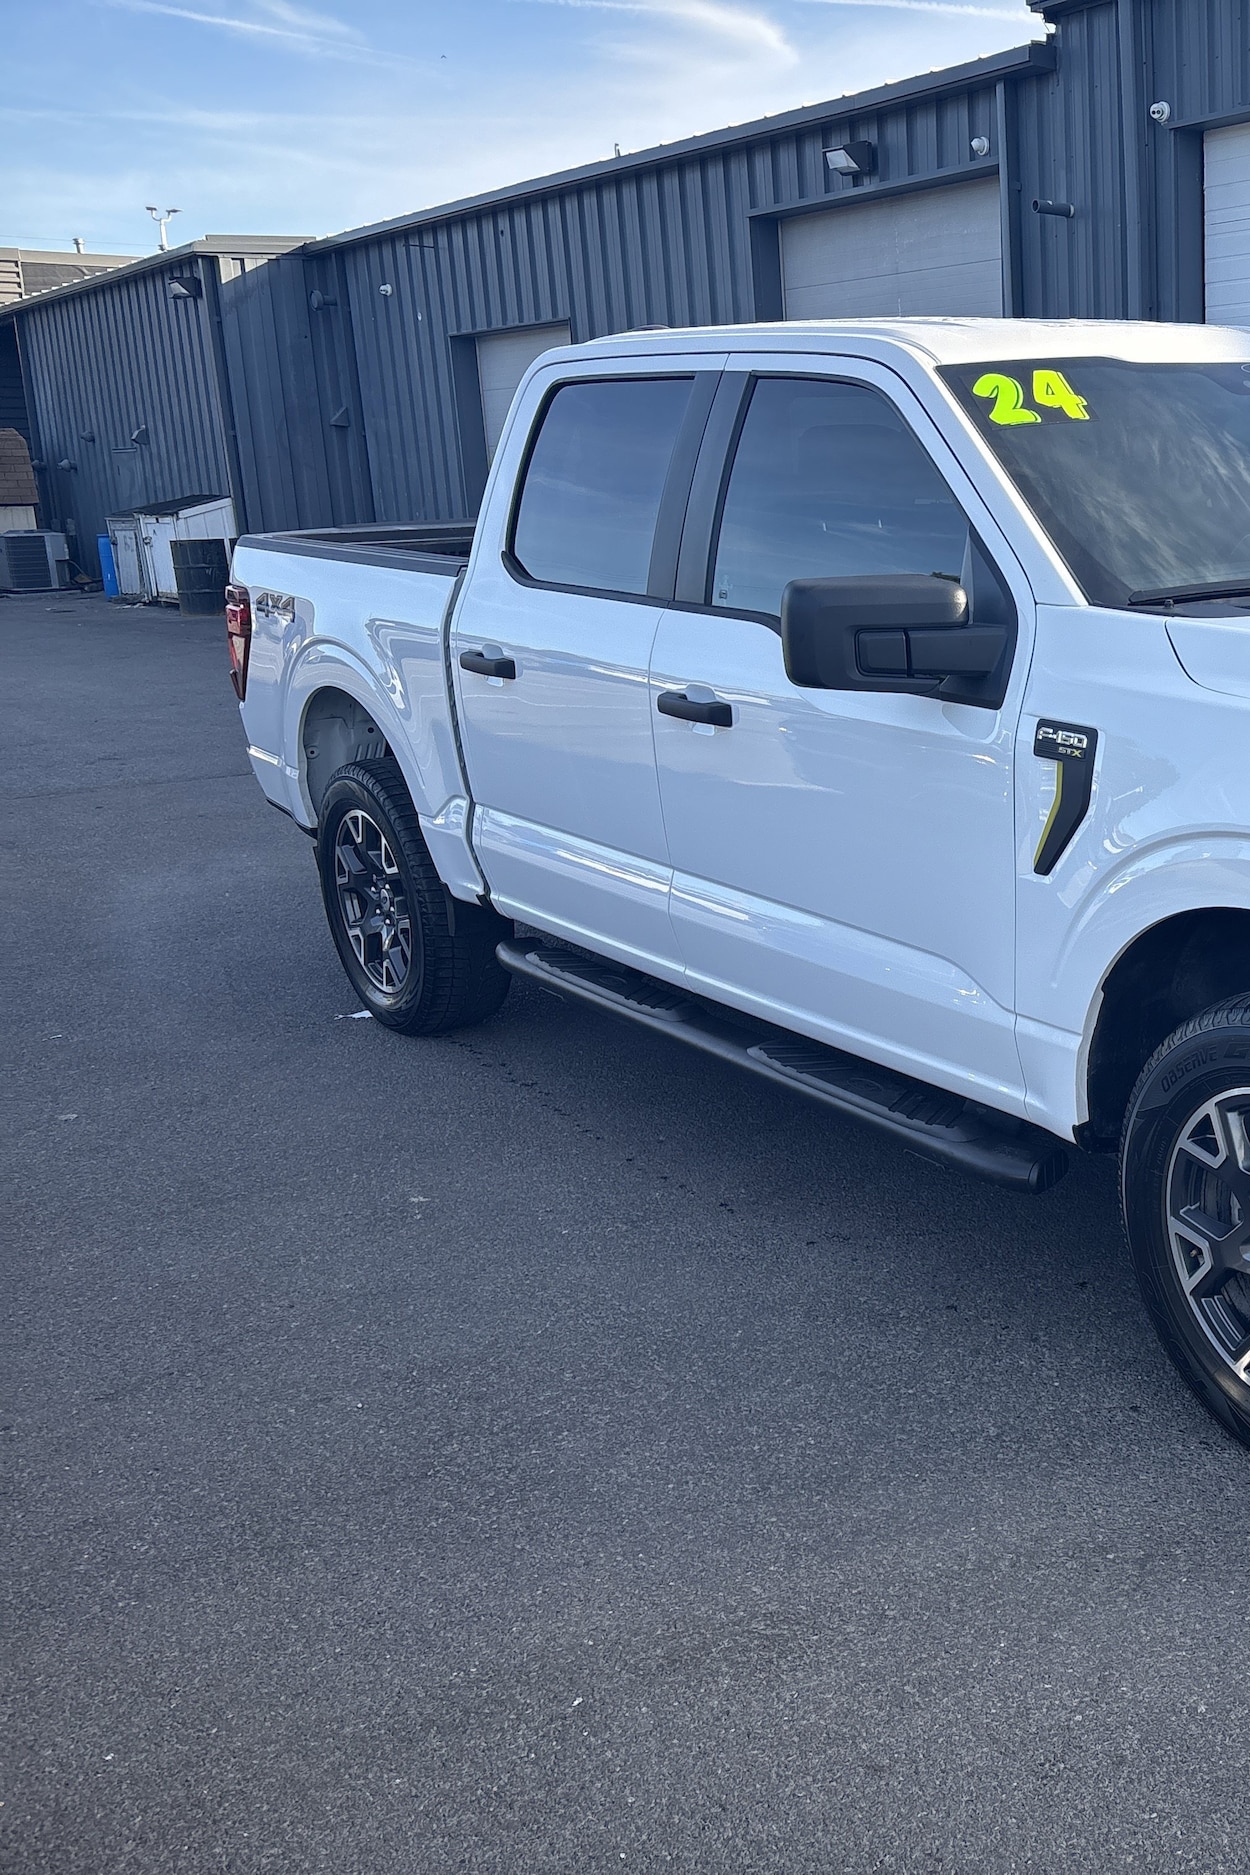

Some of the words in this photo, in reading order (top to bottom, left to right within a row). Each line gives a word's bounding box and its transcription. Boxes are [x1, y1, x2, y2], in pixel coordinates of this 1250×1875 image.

[972, 369, 1090, 425] 24
[1037, 726, 1088, 749] F-150
[1058, 746, 1082, 758] STX
